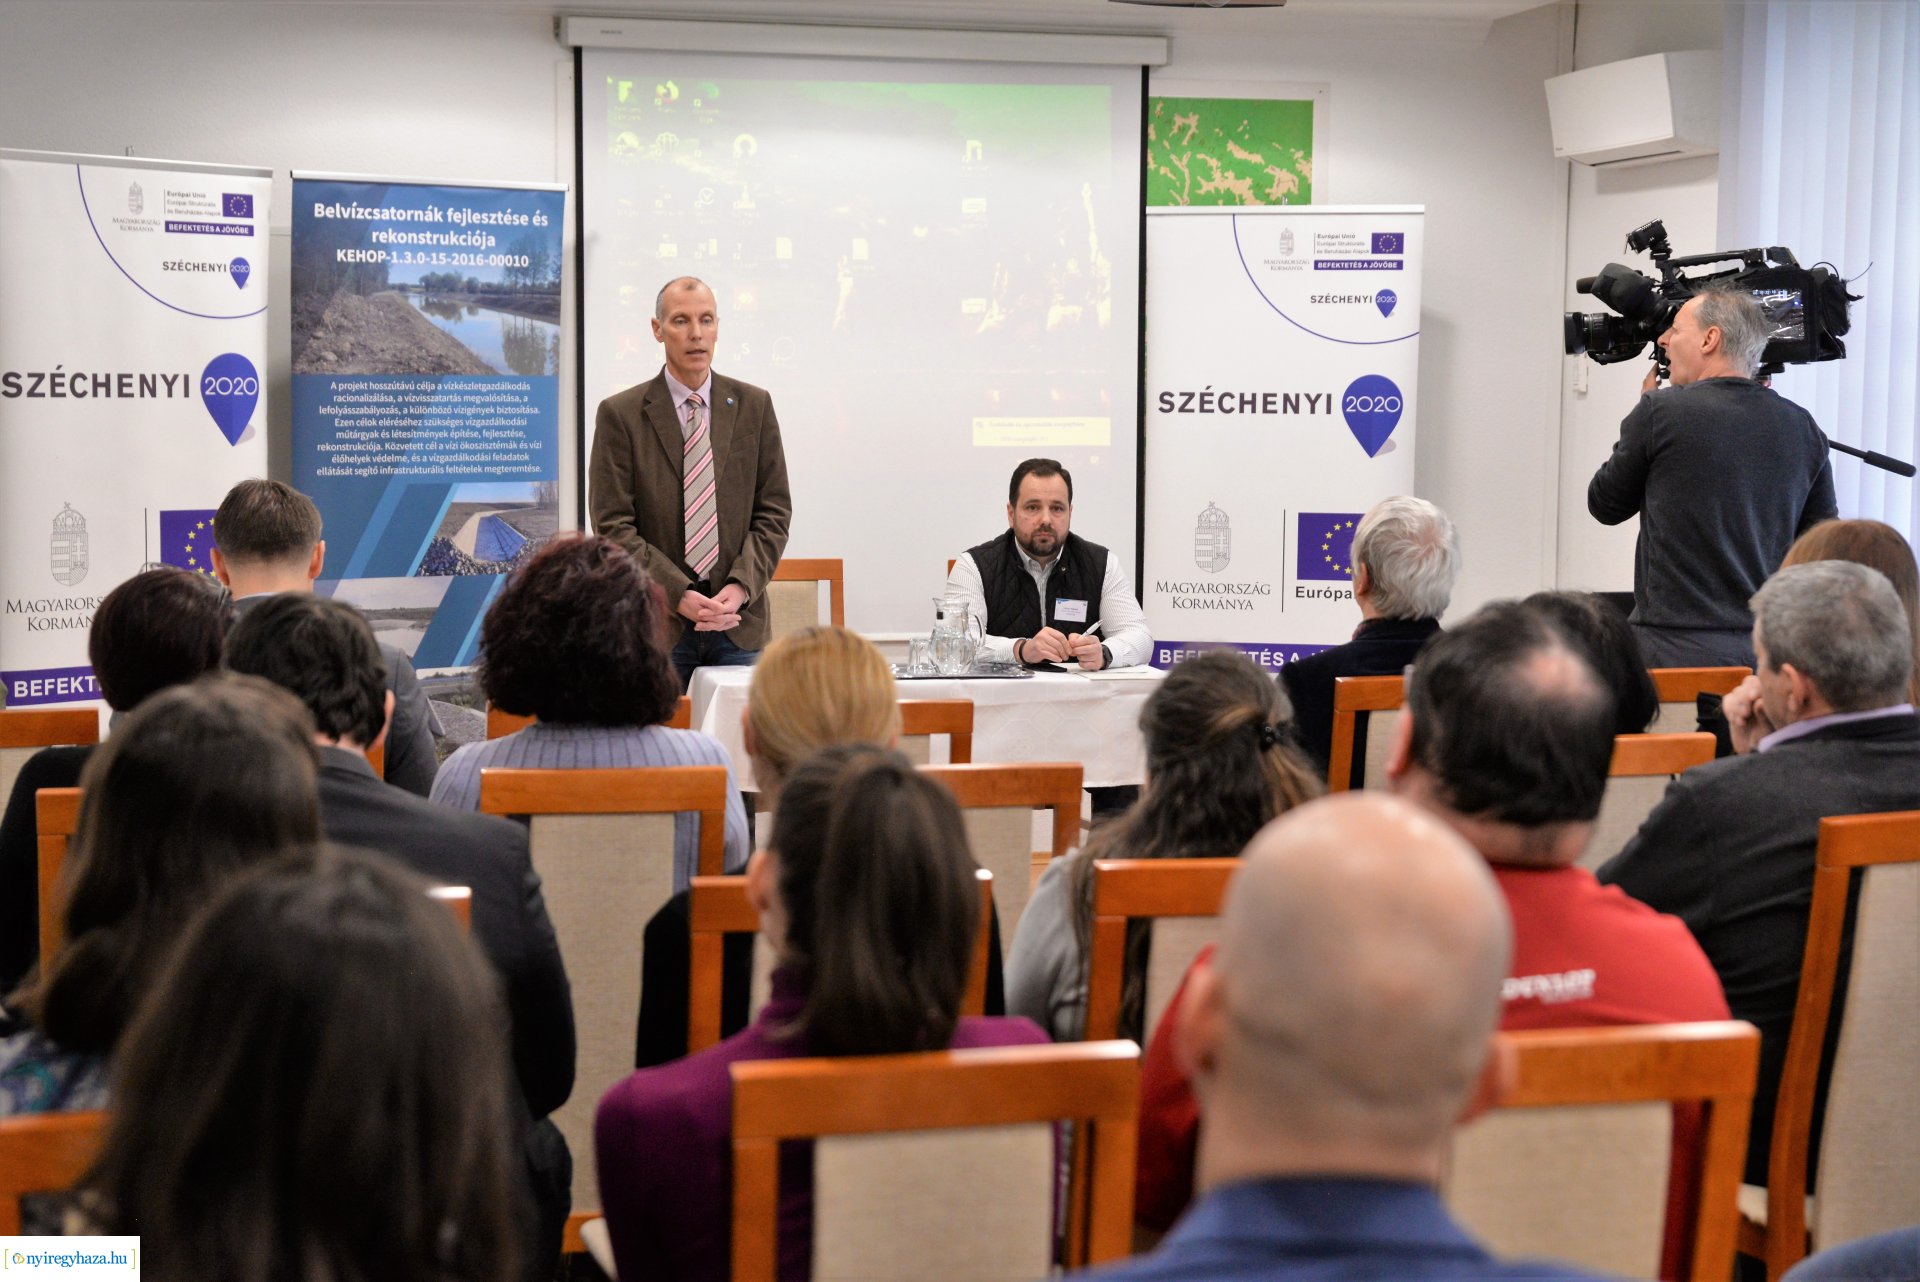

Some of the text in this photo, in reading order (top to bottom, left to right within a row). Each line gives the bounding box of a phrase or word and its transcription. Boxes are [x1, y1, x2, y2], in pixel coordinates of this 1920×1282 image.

[314, 203, 548, 227] Belvízcsatornák fejlesztése és
[169, 223, 214, 232] BEFEKTETÉS
[372, 229, 495, 249] rekonstrukciója
[337, 249, 529, 268] KEHOP-1.3.0-15-2016-00010
[163, 259, 226, 272] SZÉCHENYI
[1311, 294, 1372, 304] SZÉCHENYI
[1, 365, 258, 398] SZÉCHENYI 2020
[339, 382, 367, 394] projekt
[417, 381, 435, 393] célja
[444, 382, 530, 394] vízkészletgazdálkodás
[334, 394, 395, 403] racionalizálása,
[405, 394, 461, 402] vízvisszatartás
[464, 394, 521, 405] megvalósítása,
[1158, 386, 1401, 415] SZÉCHENYI 2020
[319, 406, 401, 416] lefolyásszabályozás,
[454, 406, 494, 415] vízigények
[497, 406, 540, 414] biztosítása.
[335, 418, 527, 428] Ezen célok eléréséhez szükséges vízgazdálkodási
[336, 431, 379, 440] műtárgyak
[392, 430, 448, 439] létesítmények
[450, 430, 480, 439] építése,
[483, 430, 525, 439] fejlesztése,
[318, 443, 382, 452] rekonstrukciója.
[385, 442, 423, 450] Közvetett
[426, 442, 437, 450] cél
[460, 441, 517, 449] ökoszisztémák
[332, 455, 370, 464] élőhelyek
[373, 454, 409, 463] védelme,
[412, 454, 420, 462] és
[429, 454, 490, 463] vízgazdálkodási
[493, 453, 529, 461] feladatok
[317, 464, 542, 476] ellátását segítő infrastrukturális feltételek megteremtése.
[1155, 581, 1271, 595] MAGYARORSZÁG
[1295, 586, 1352, 601] Európa
[6, 597, 104, 613] MAGYARORS
[1172, 596, 1253, 610] KORMÁNYA
[14, 676, 102, 698] BEFEKT
